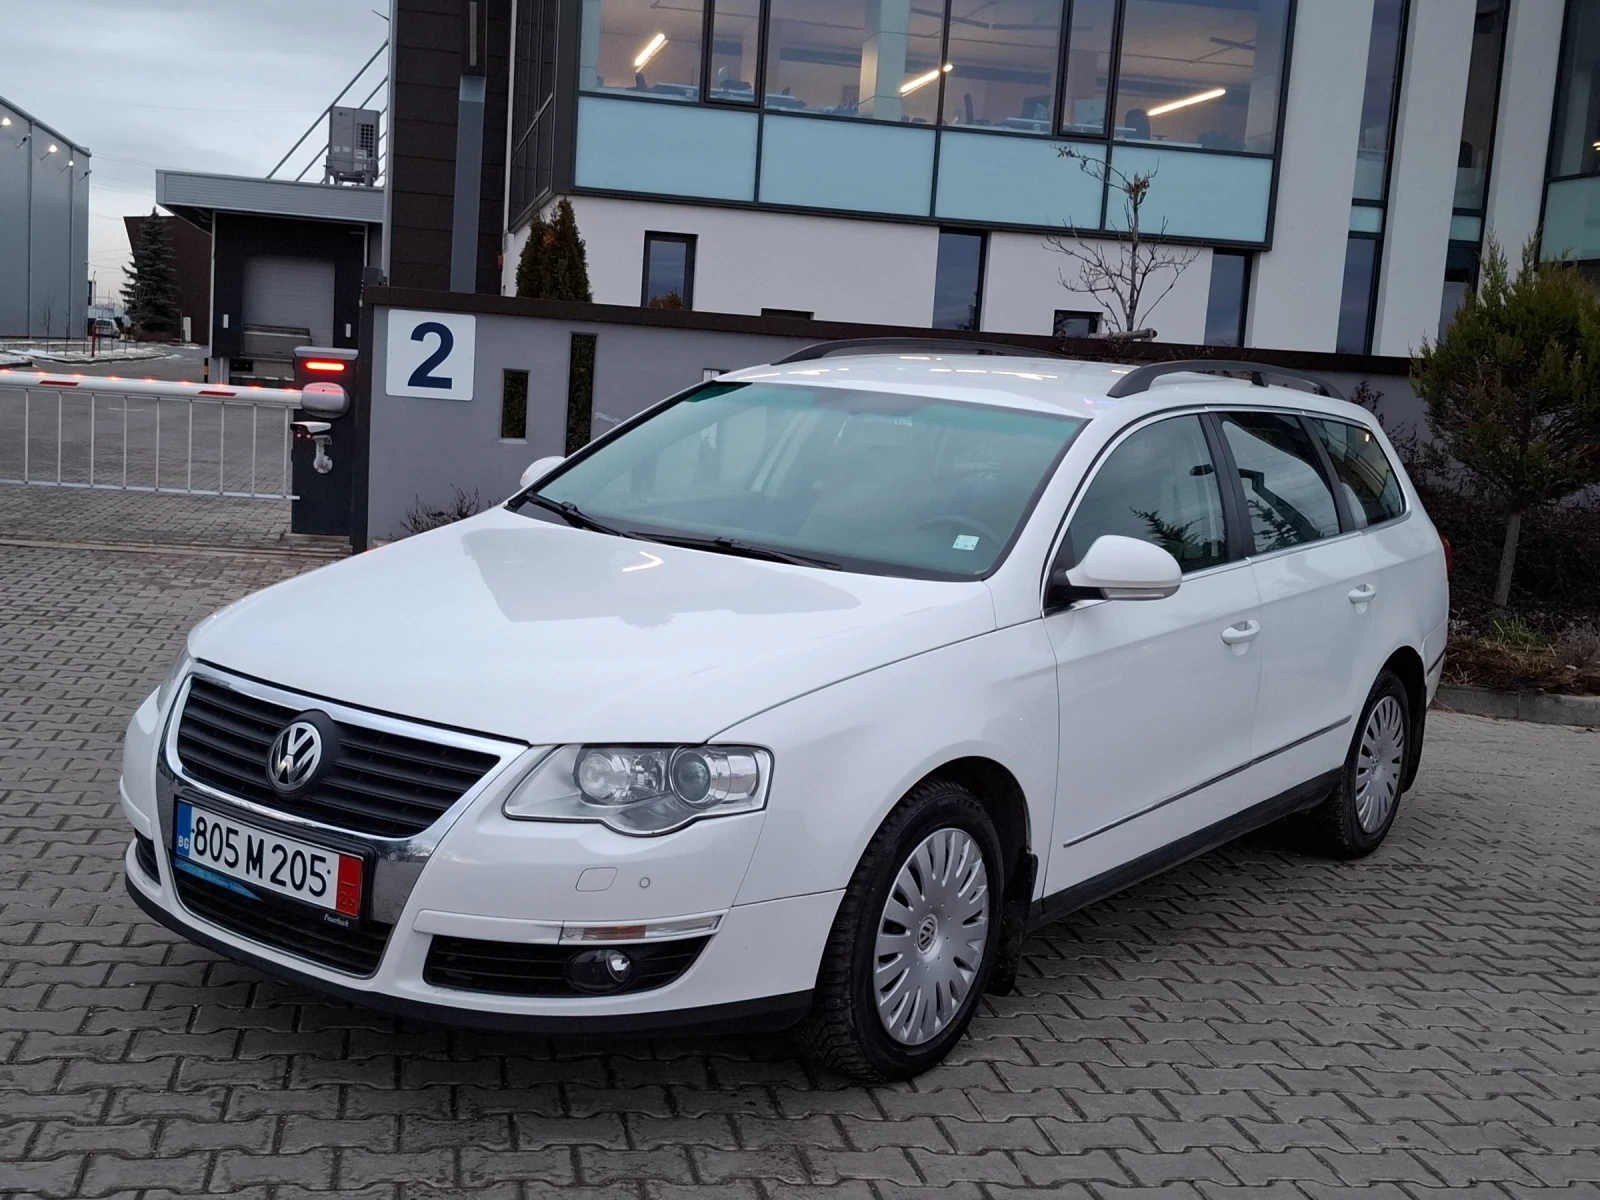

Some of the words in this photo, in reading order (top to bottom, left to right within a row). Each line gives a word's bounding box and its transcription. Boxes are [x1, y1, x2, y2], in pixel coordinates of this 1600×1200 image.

[407, 321, 455, 390] 2
[178, 835, 190, 849] BG
[194, 816, 240, 869] 805
[245, 834, 265, 879] M
[269, 843, 327, 897] 205
